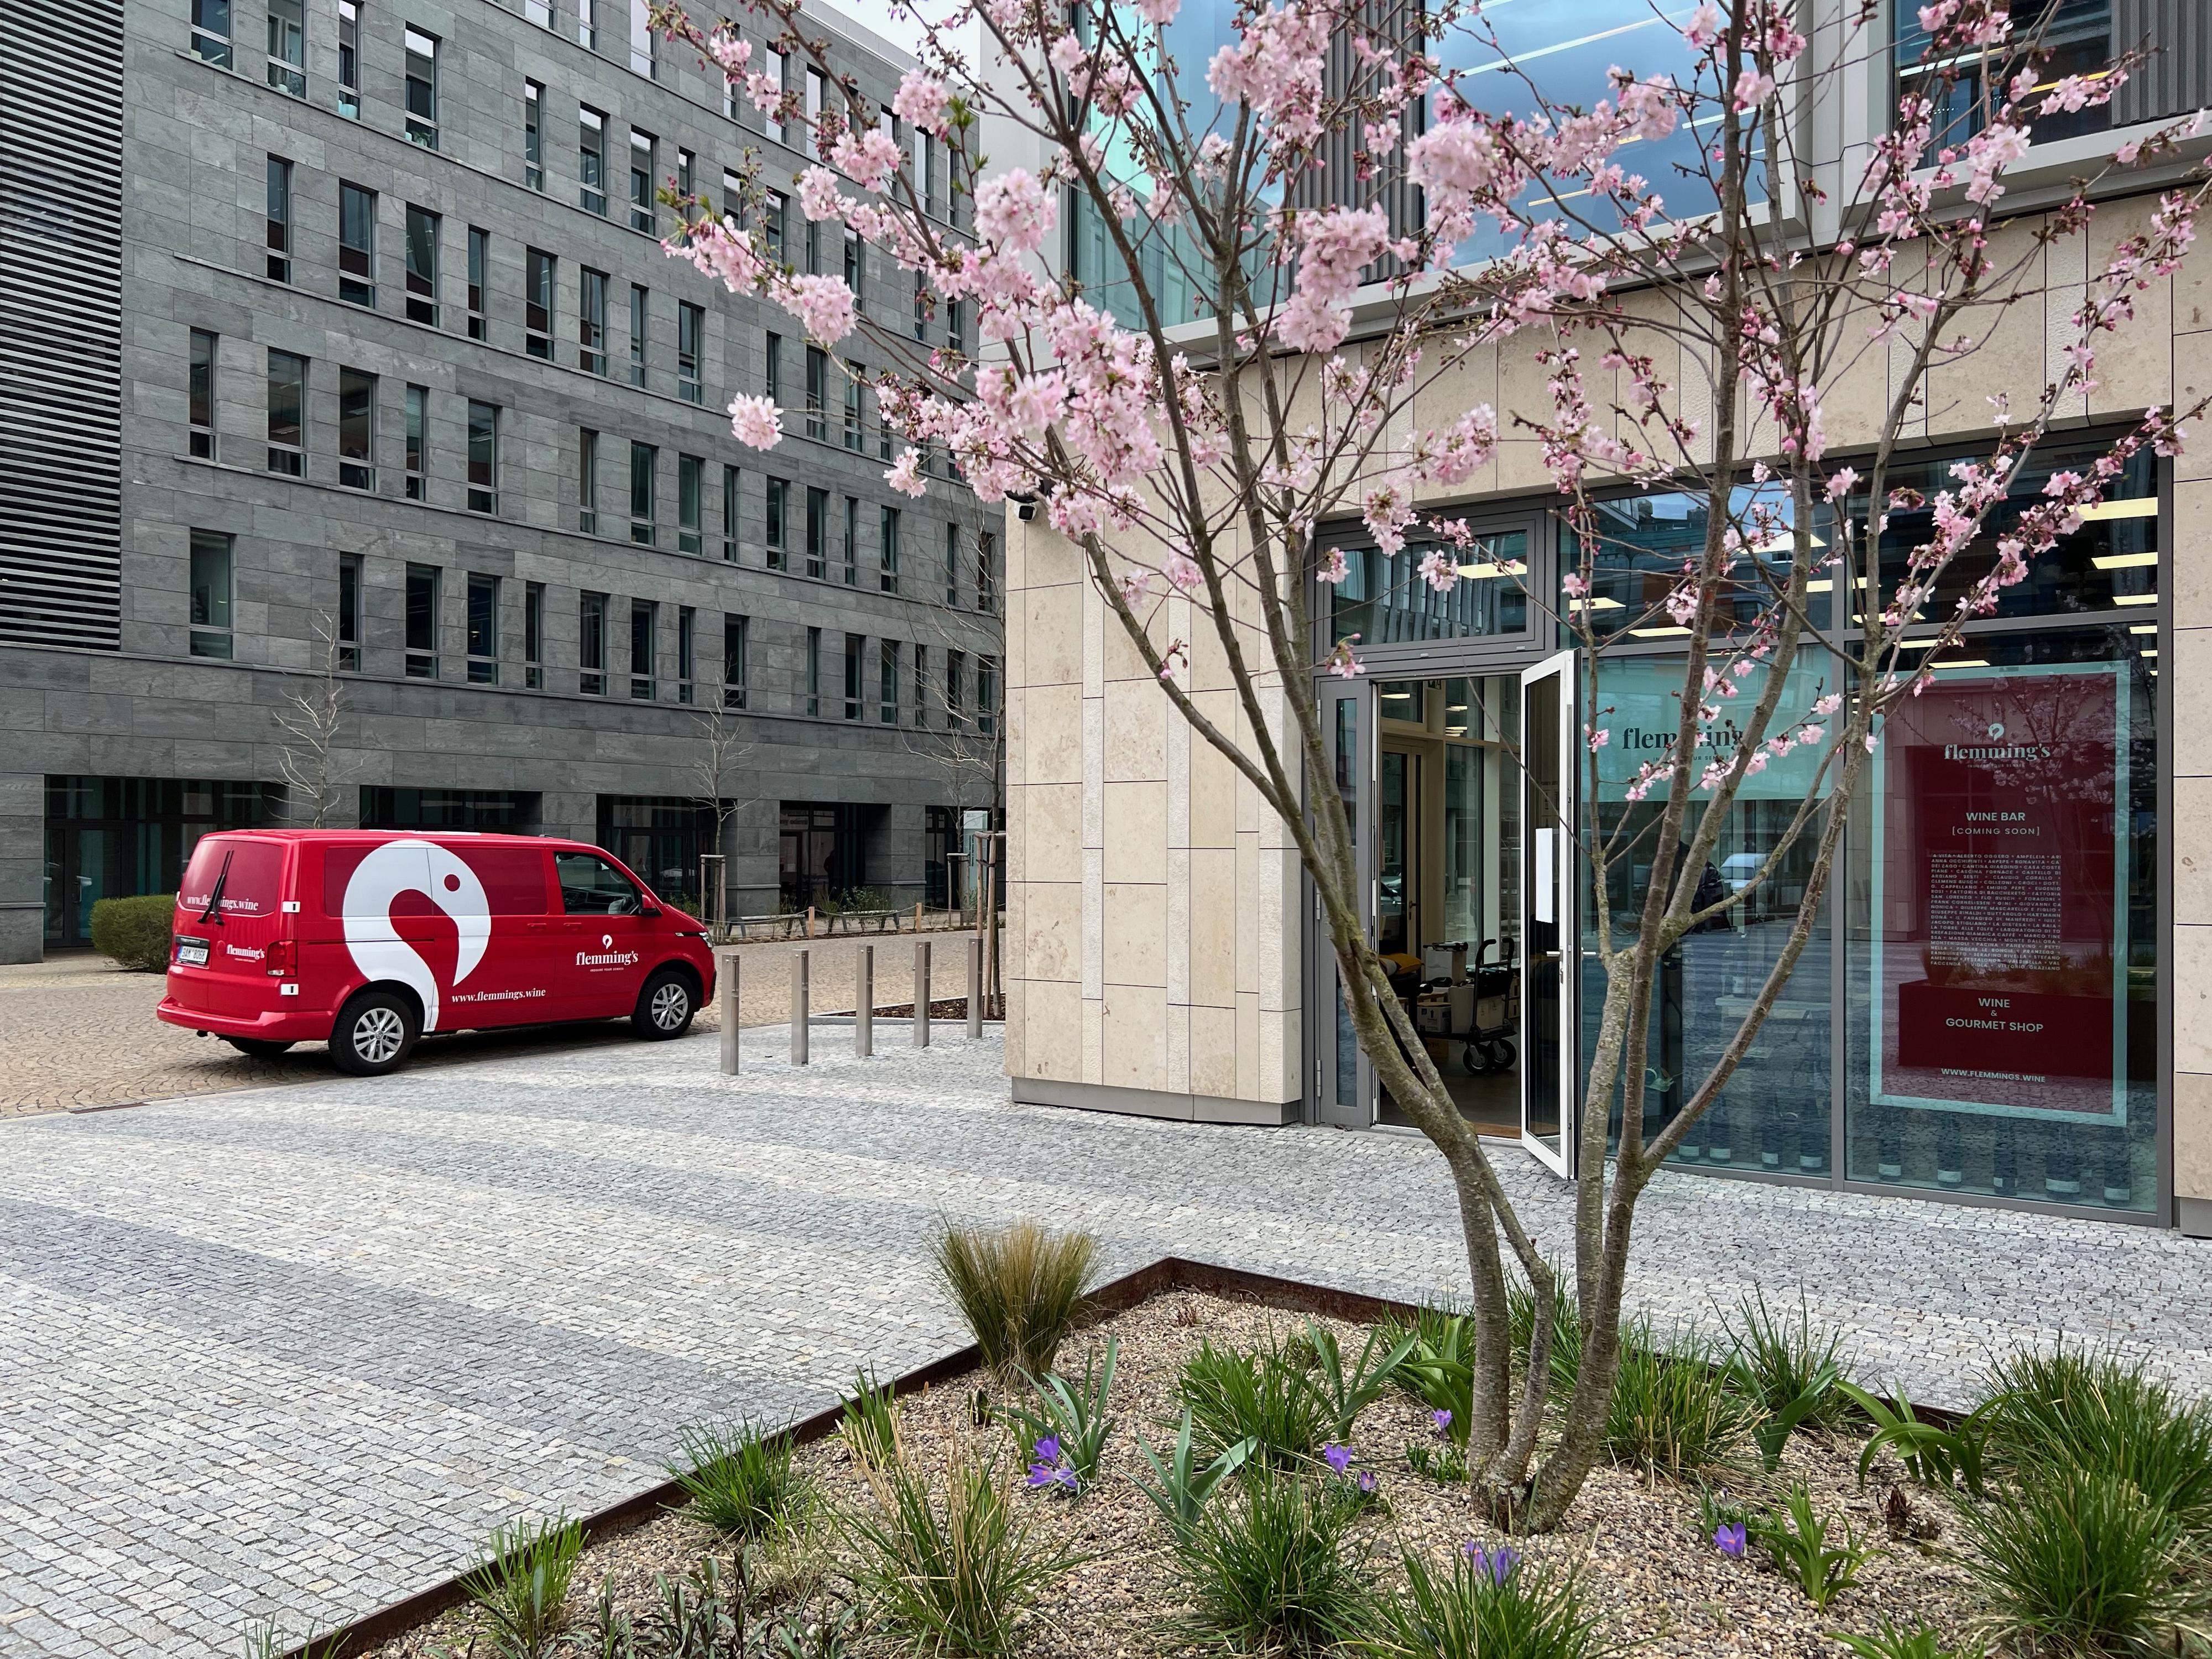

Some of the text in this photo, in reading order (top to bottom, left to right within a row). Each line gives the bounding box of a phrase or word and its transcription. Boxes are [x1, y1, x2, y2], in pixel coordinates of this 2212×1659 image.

[1944, 743, 2051, 761] flemming's
[1966, 812, 2025, 821] WINE BAR
[1952, 826, 2039, 836] [COMING SOON]
[575, 950, 639, 966] flemming's
[451, 988, 546, 1003] www.flemmings.wine
[1978, 997, 2010, 1008] WINE
[1945, 1018, 2044, 1032] GOURMET SHOP
[1941, 1068, 2046, 1083] WWW.FLEMMINGS.WINE
